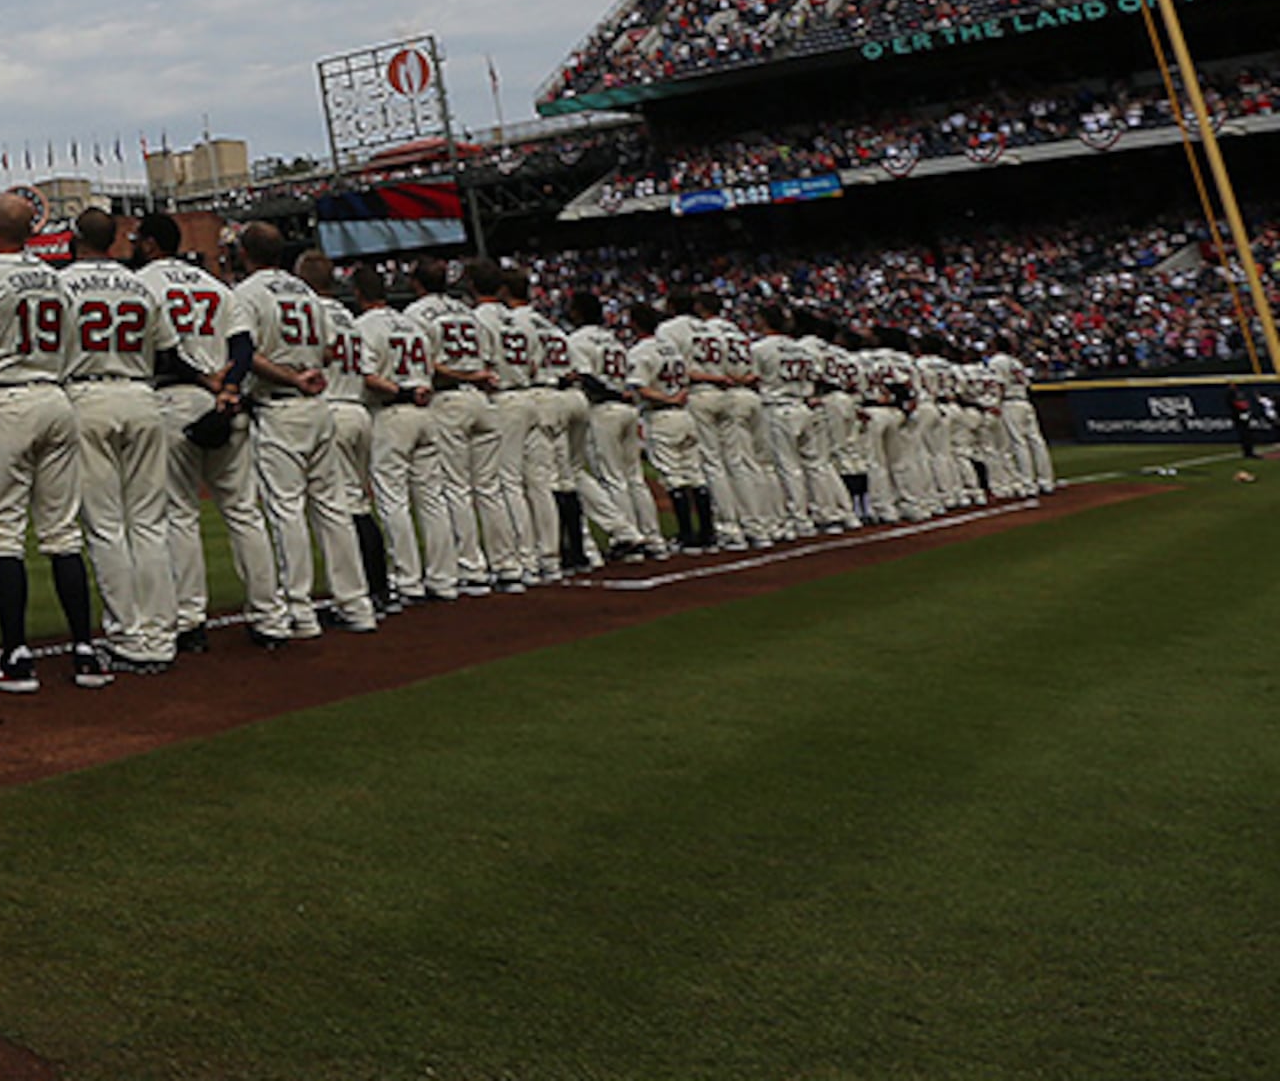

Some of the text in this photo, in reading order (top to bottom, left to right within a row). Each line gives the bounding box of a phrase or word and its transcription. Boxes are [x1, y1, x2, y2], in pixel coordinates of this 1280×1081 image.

[943, 19, 1003, 45] THE
[1012, 0, 1108, 33] LAND
[16, 299, 62, 355] 19
[79, 301, 147, 352] 22
[166, 288, 221, 336] 27
[277, 300, 319, 346] 51
[388, 336, 429, 376] 74
[441, 321, 480, 359] 55
